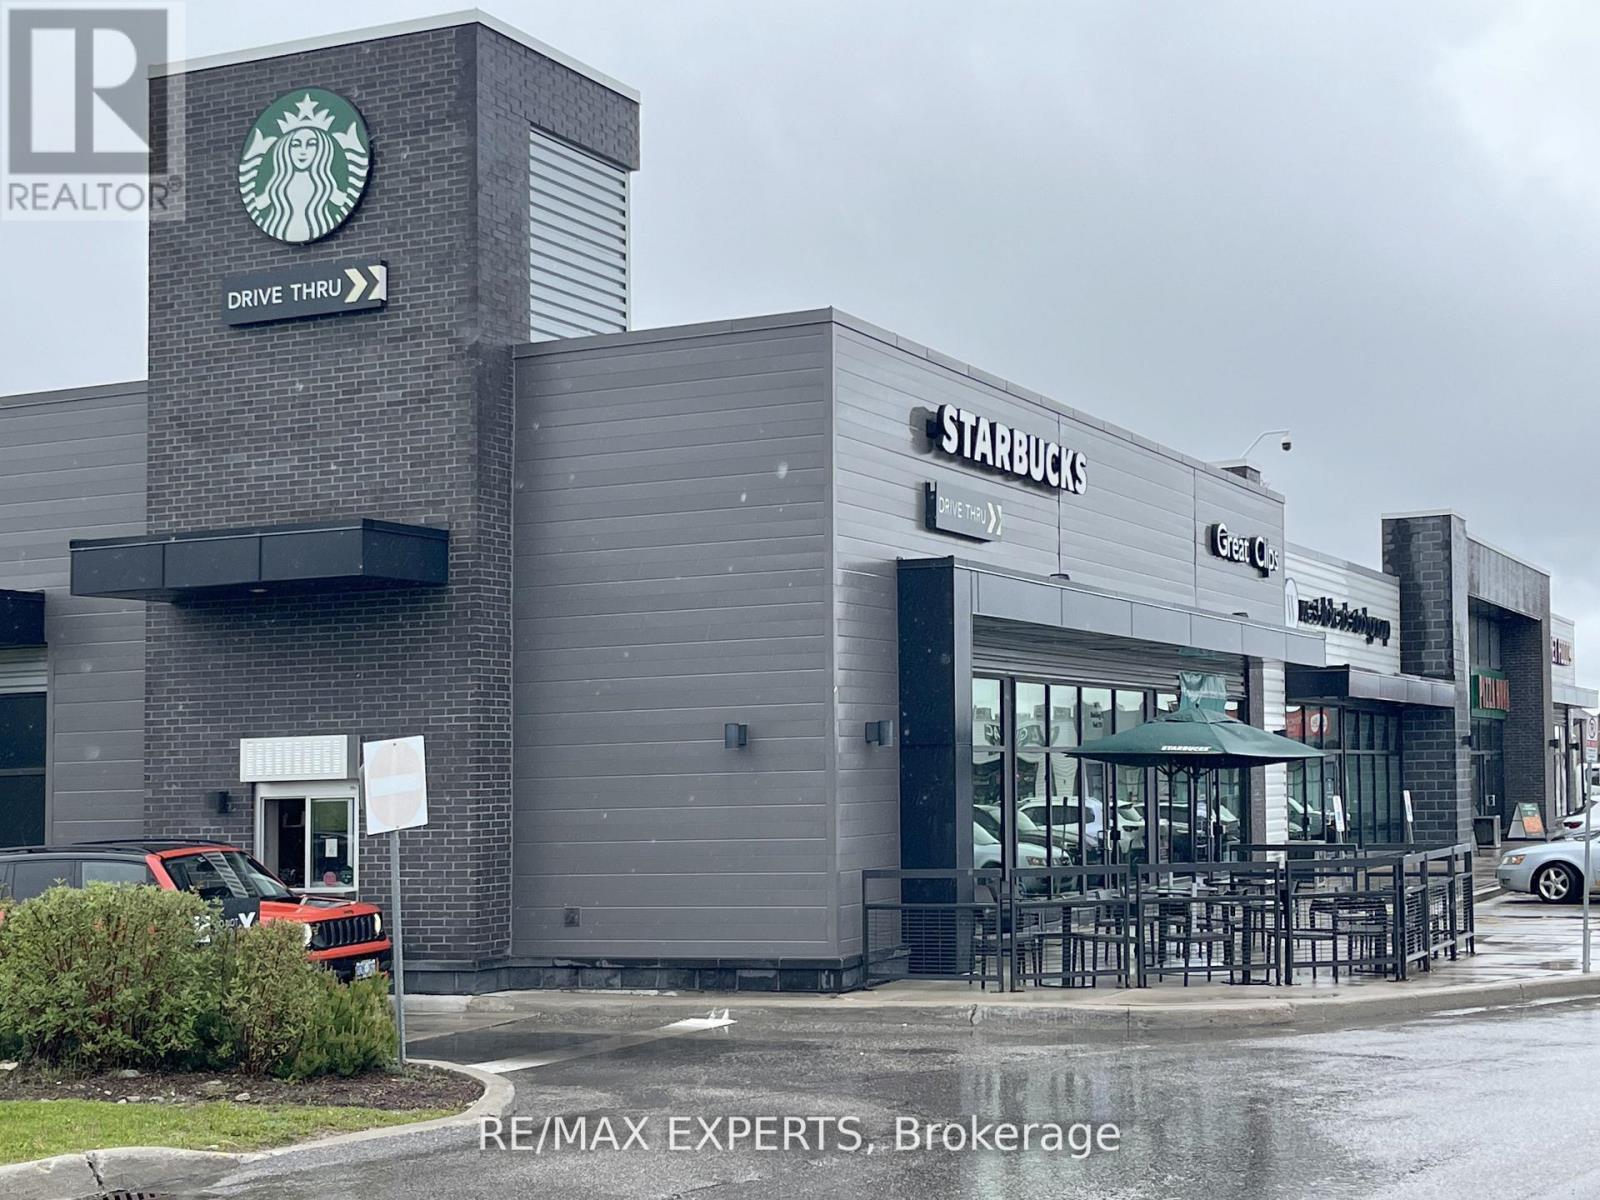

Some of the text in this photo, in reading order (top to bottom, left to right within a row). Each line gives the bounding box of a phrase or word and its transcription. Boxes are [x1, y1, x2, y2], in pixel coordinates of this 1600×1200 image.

[228, 278, 342, 309] DRIVE THRU
[940, 403, 1088, 495] STARBUCKS
[938, 496, 987, 525] DRIVE THRU
[1216, 523, 1279, 576] Great Clips
